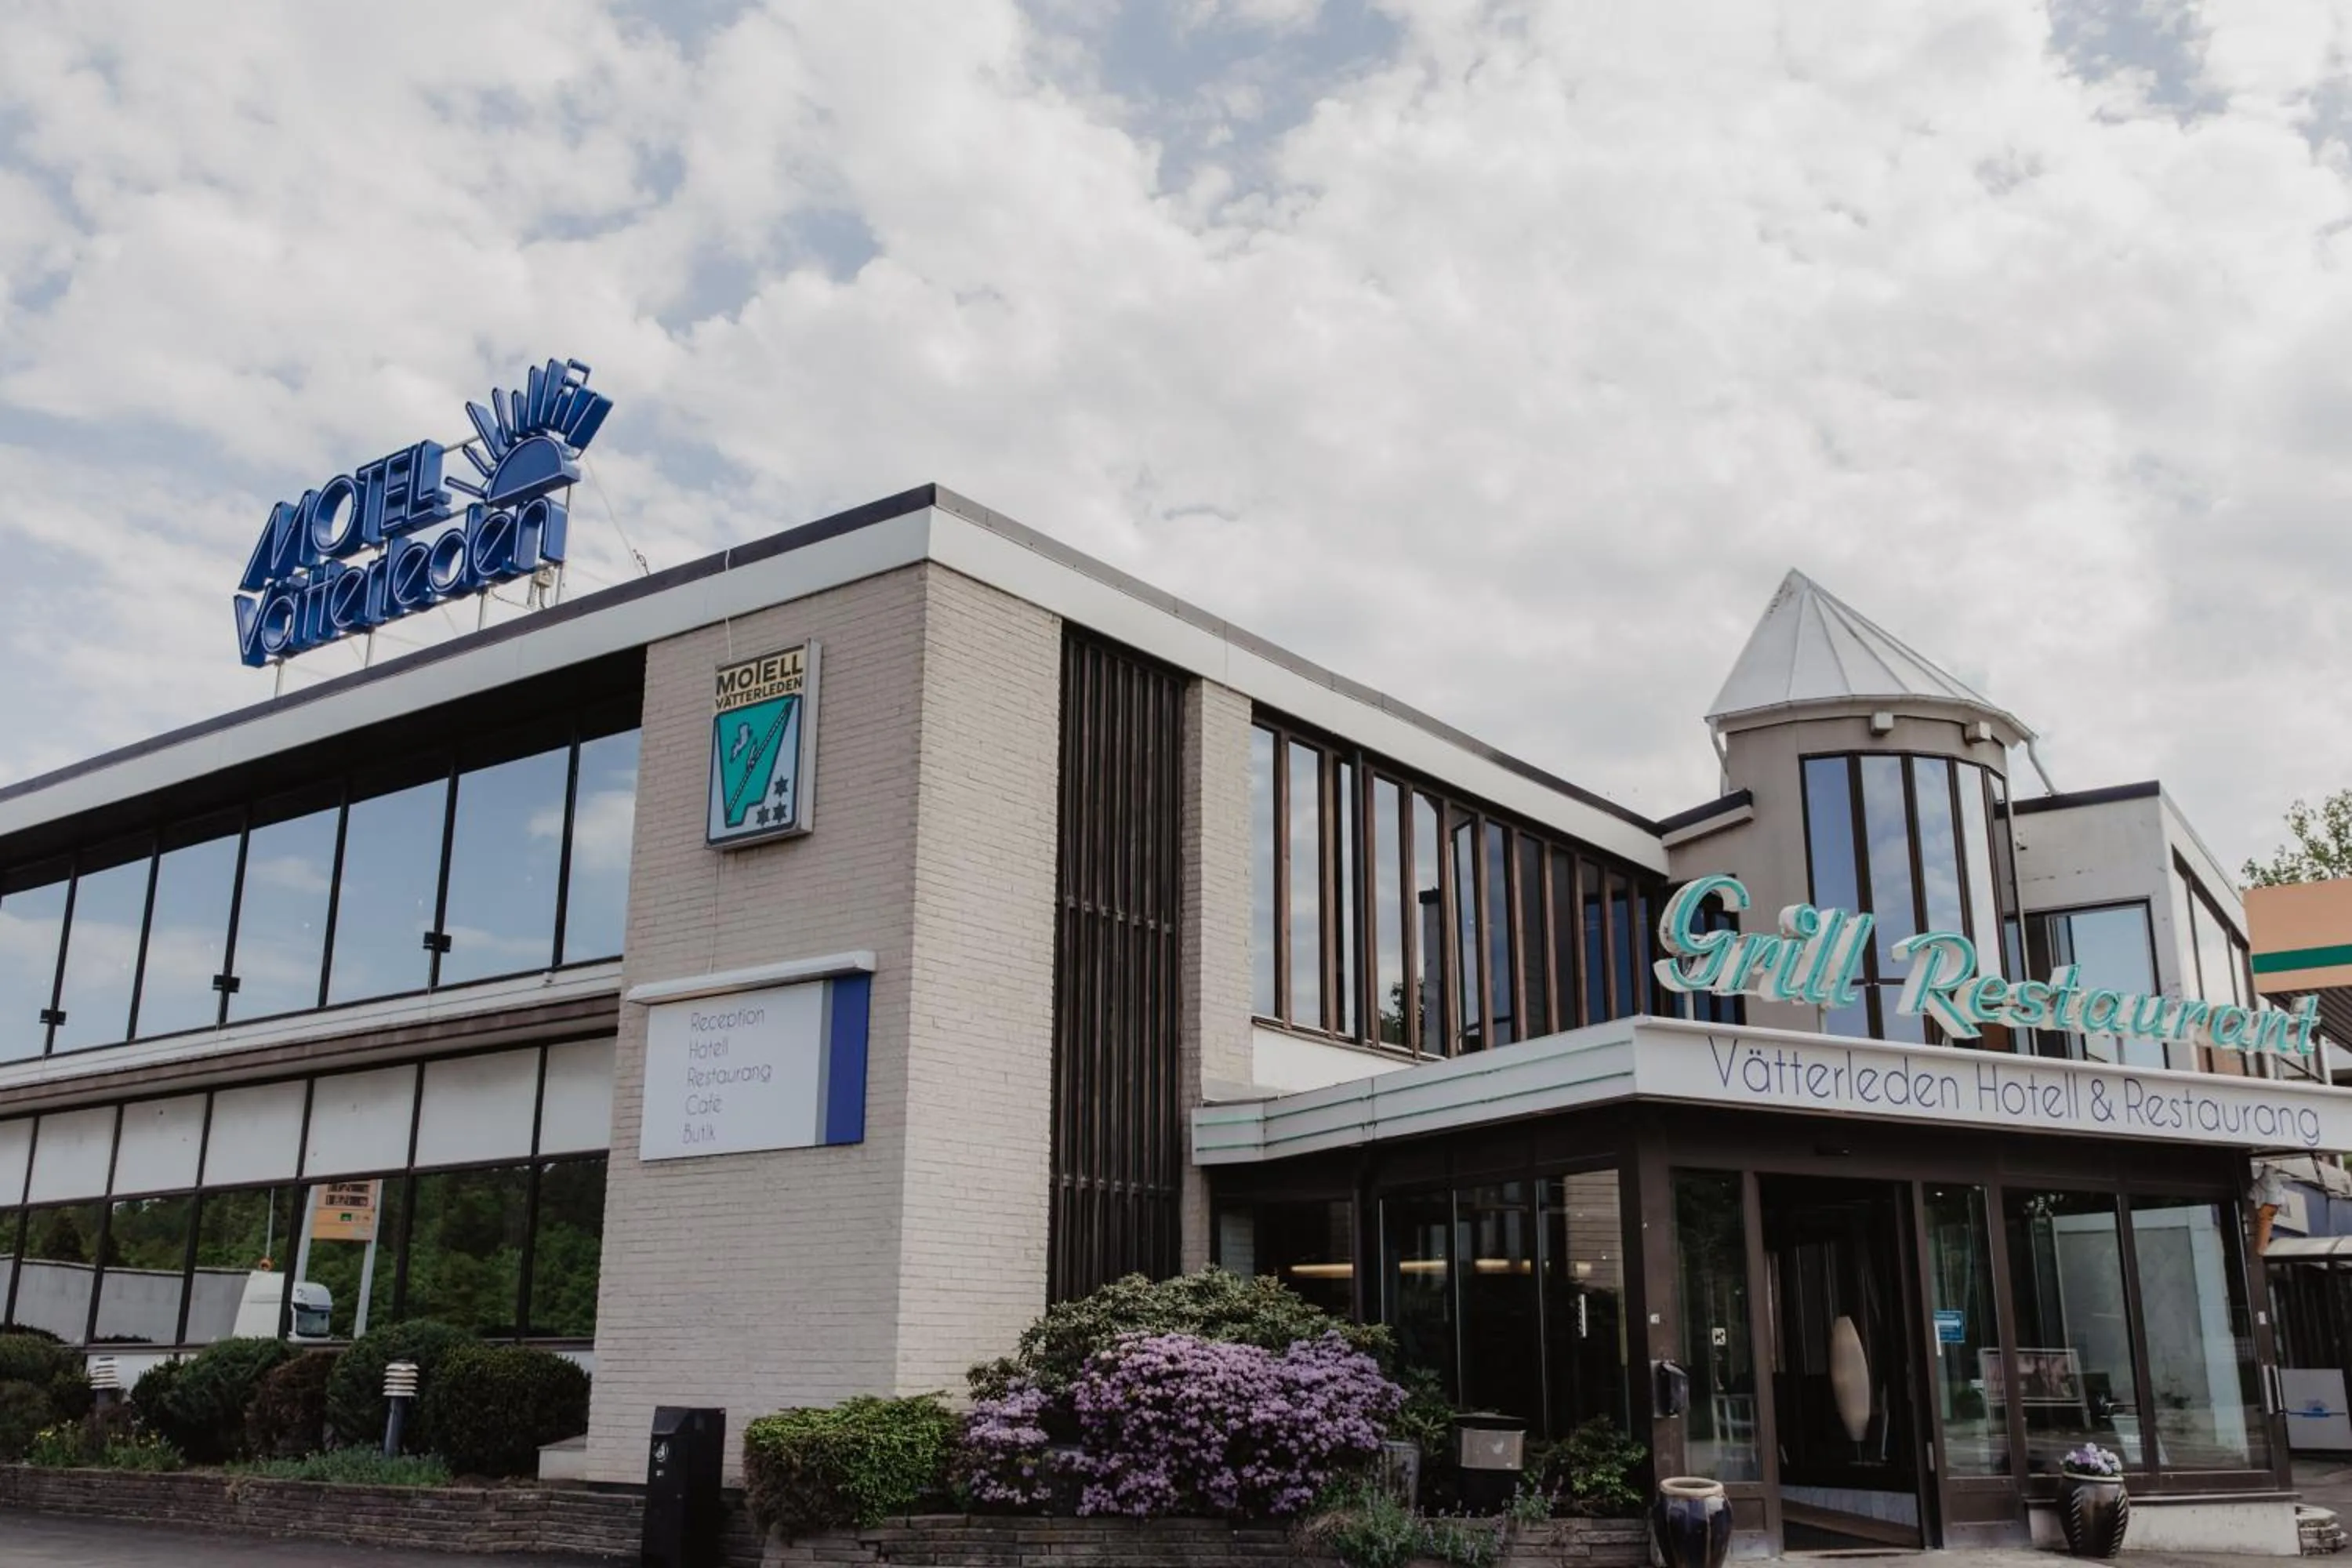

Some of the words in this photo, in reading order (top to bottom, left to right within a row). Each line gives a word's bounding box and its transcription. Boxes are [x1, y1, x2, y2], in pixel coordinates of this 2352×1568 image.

[238, 438, 452, 591] MOTEL
[717, 652, 803, 696] MOTELL
[1653, 874, 1875, 1010] Grill
[1892, 931, 2322, 1057] Restaurant
[690, 1007, 765, 1033] Reception
[688, 1037, 729, 1060] Hotell
[687, 1063, 773, 1089] Restaurang
[1707, 1035, 1960, 1109] Vätterleden
[1976, 1062, 2080, 1120] Hotell
[2089, 1078, 2117, 1123] &
[2123, 1077, 2321, 1147] Restaurang
[681, 1121, 717, 1145] Butik
